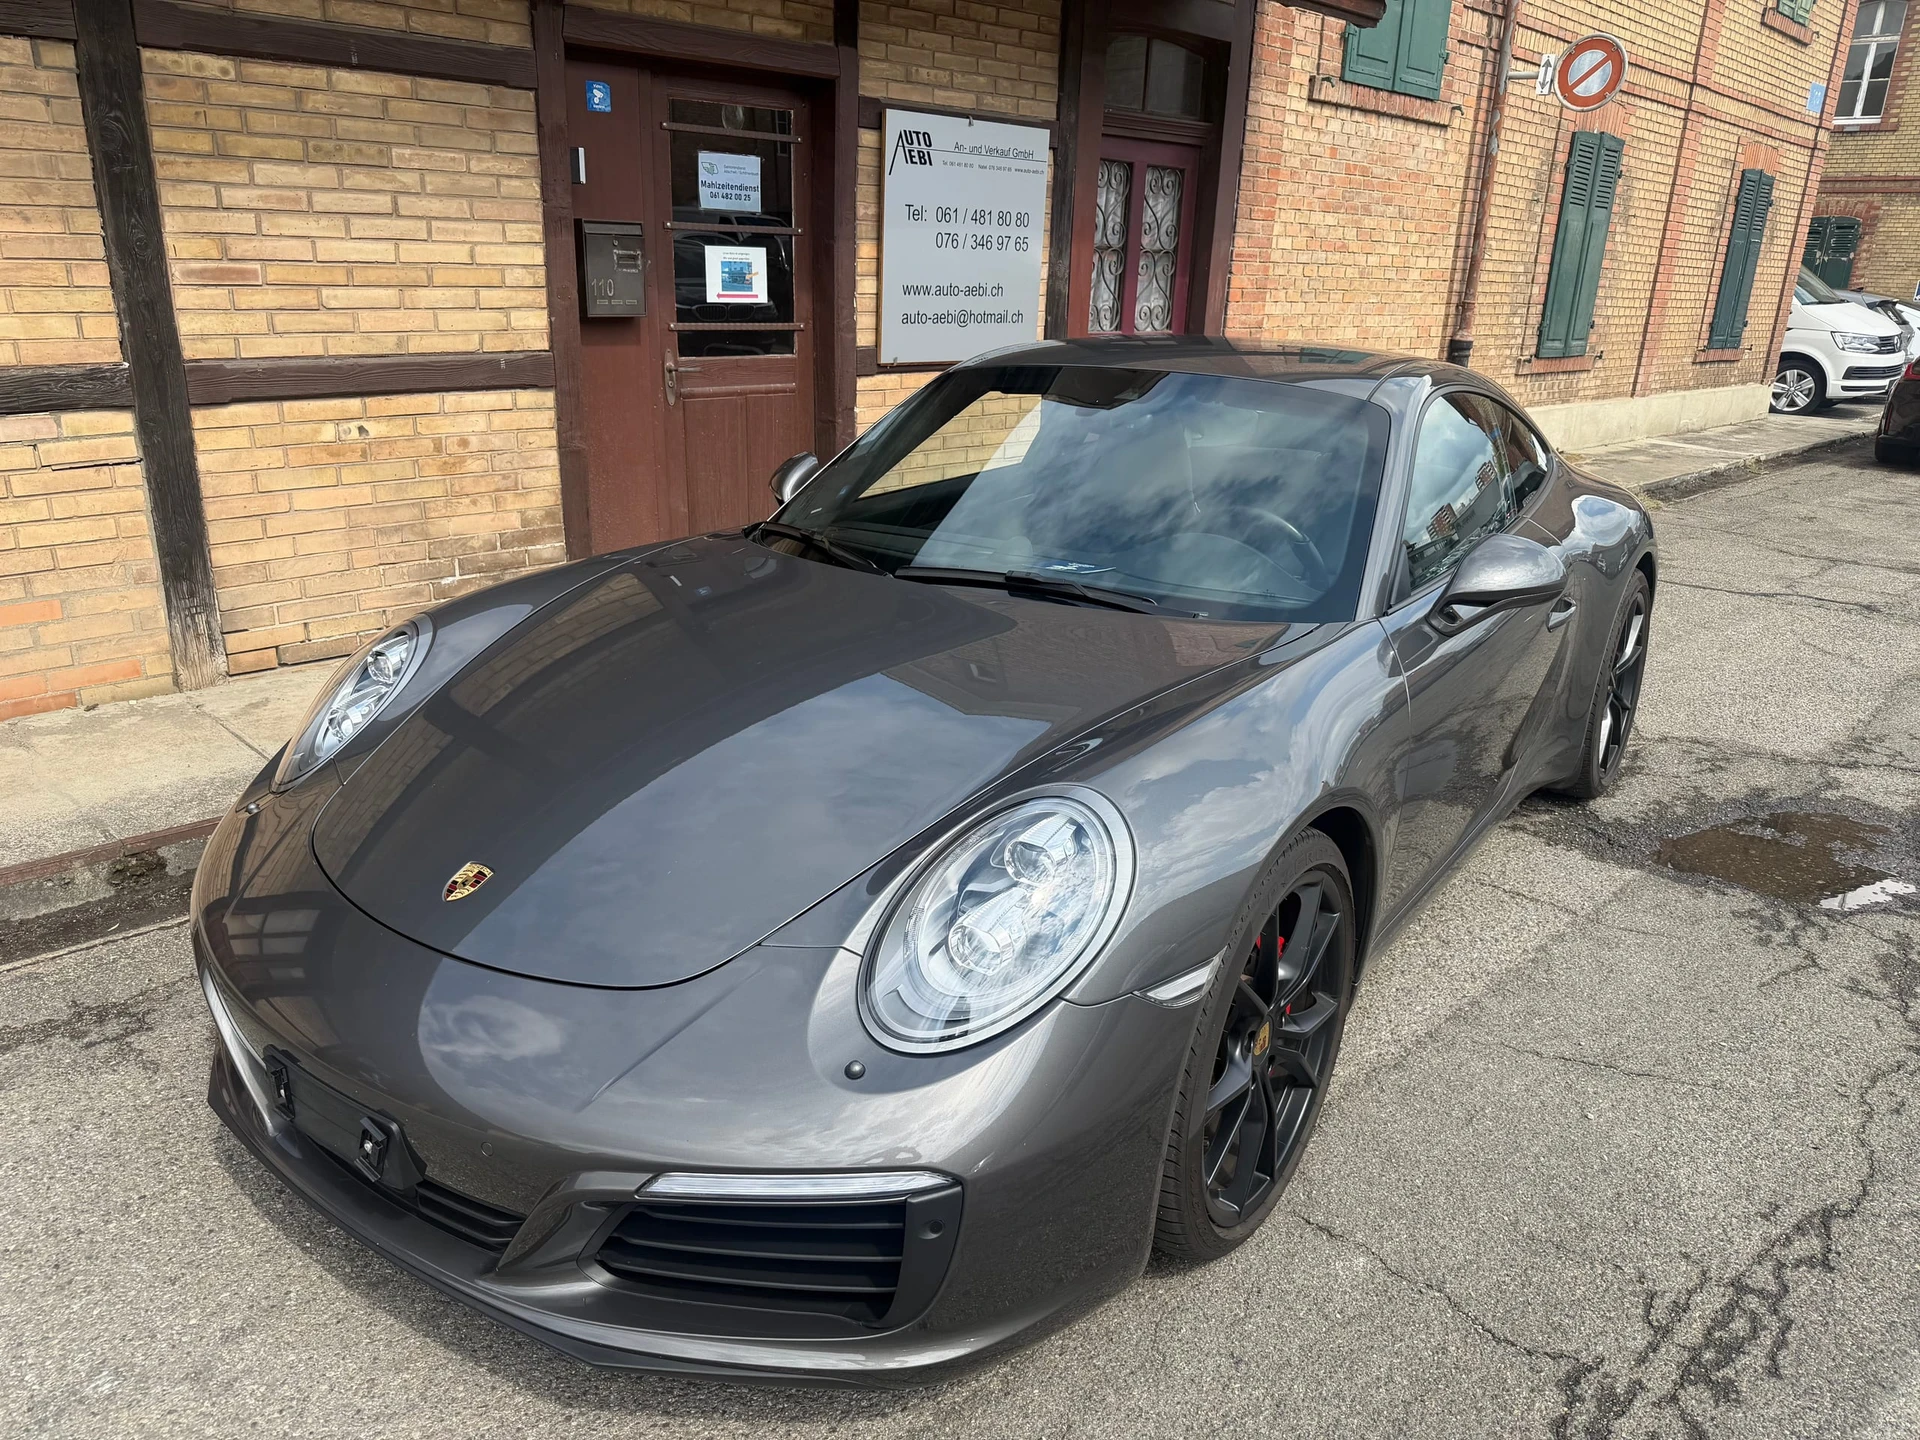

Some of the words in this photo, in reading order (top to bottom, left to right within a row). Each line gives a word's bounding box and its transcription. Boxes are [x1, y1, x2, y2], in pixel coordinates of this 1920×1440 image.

[954, 142, 967, 151] An-
[969, 144, 983, 154] und
[984, 145, 1011, 157] Verkauf
[1012, 148, 1034, 160] GmbH
[700, 180, 760, 192] Mahlzeitendienst
[905, 204, 928, 222] Tel:
[936, 206, 958, 224] 061
[971, 209, 992, 226] 481
[997, 211, 1012, 227] 80
[1015, 212, 1030, 228] 80
[936, 232, 959, 249] 076
[971, 234, 993, 250] 346
[996, 236, 1011, 251] 97
[1014, 236, 1029, 252] 65
[592, 278, 614, 296] 110
[902, 282, 1004, 297] www.auto-aebi.ch
[902, 309, 1024, 328] auto-aebi@hotmail.ch
